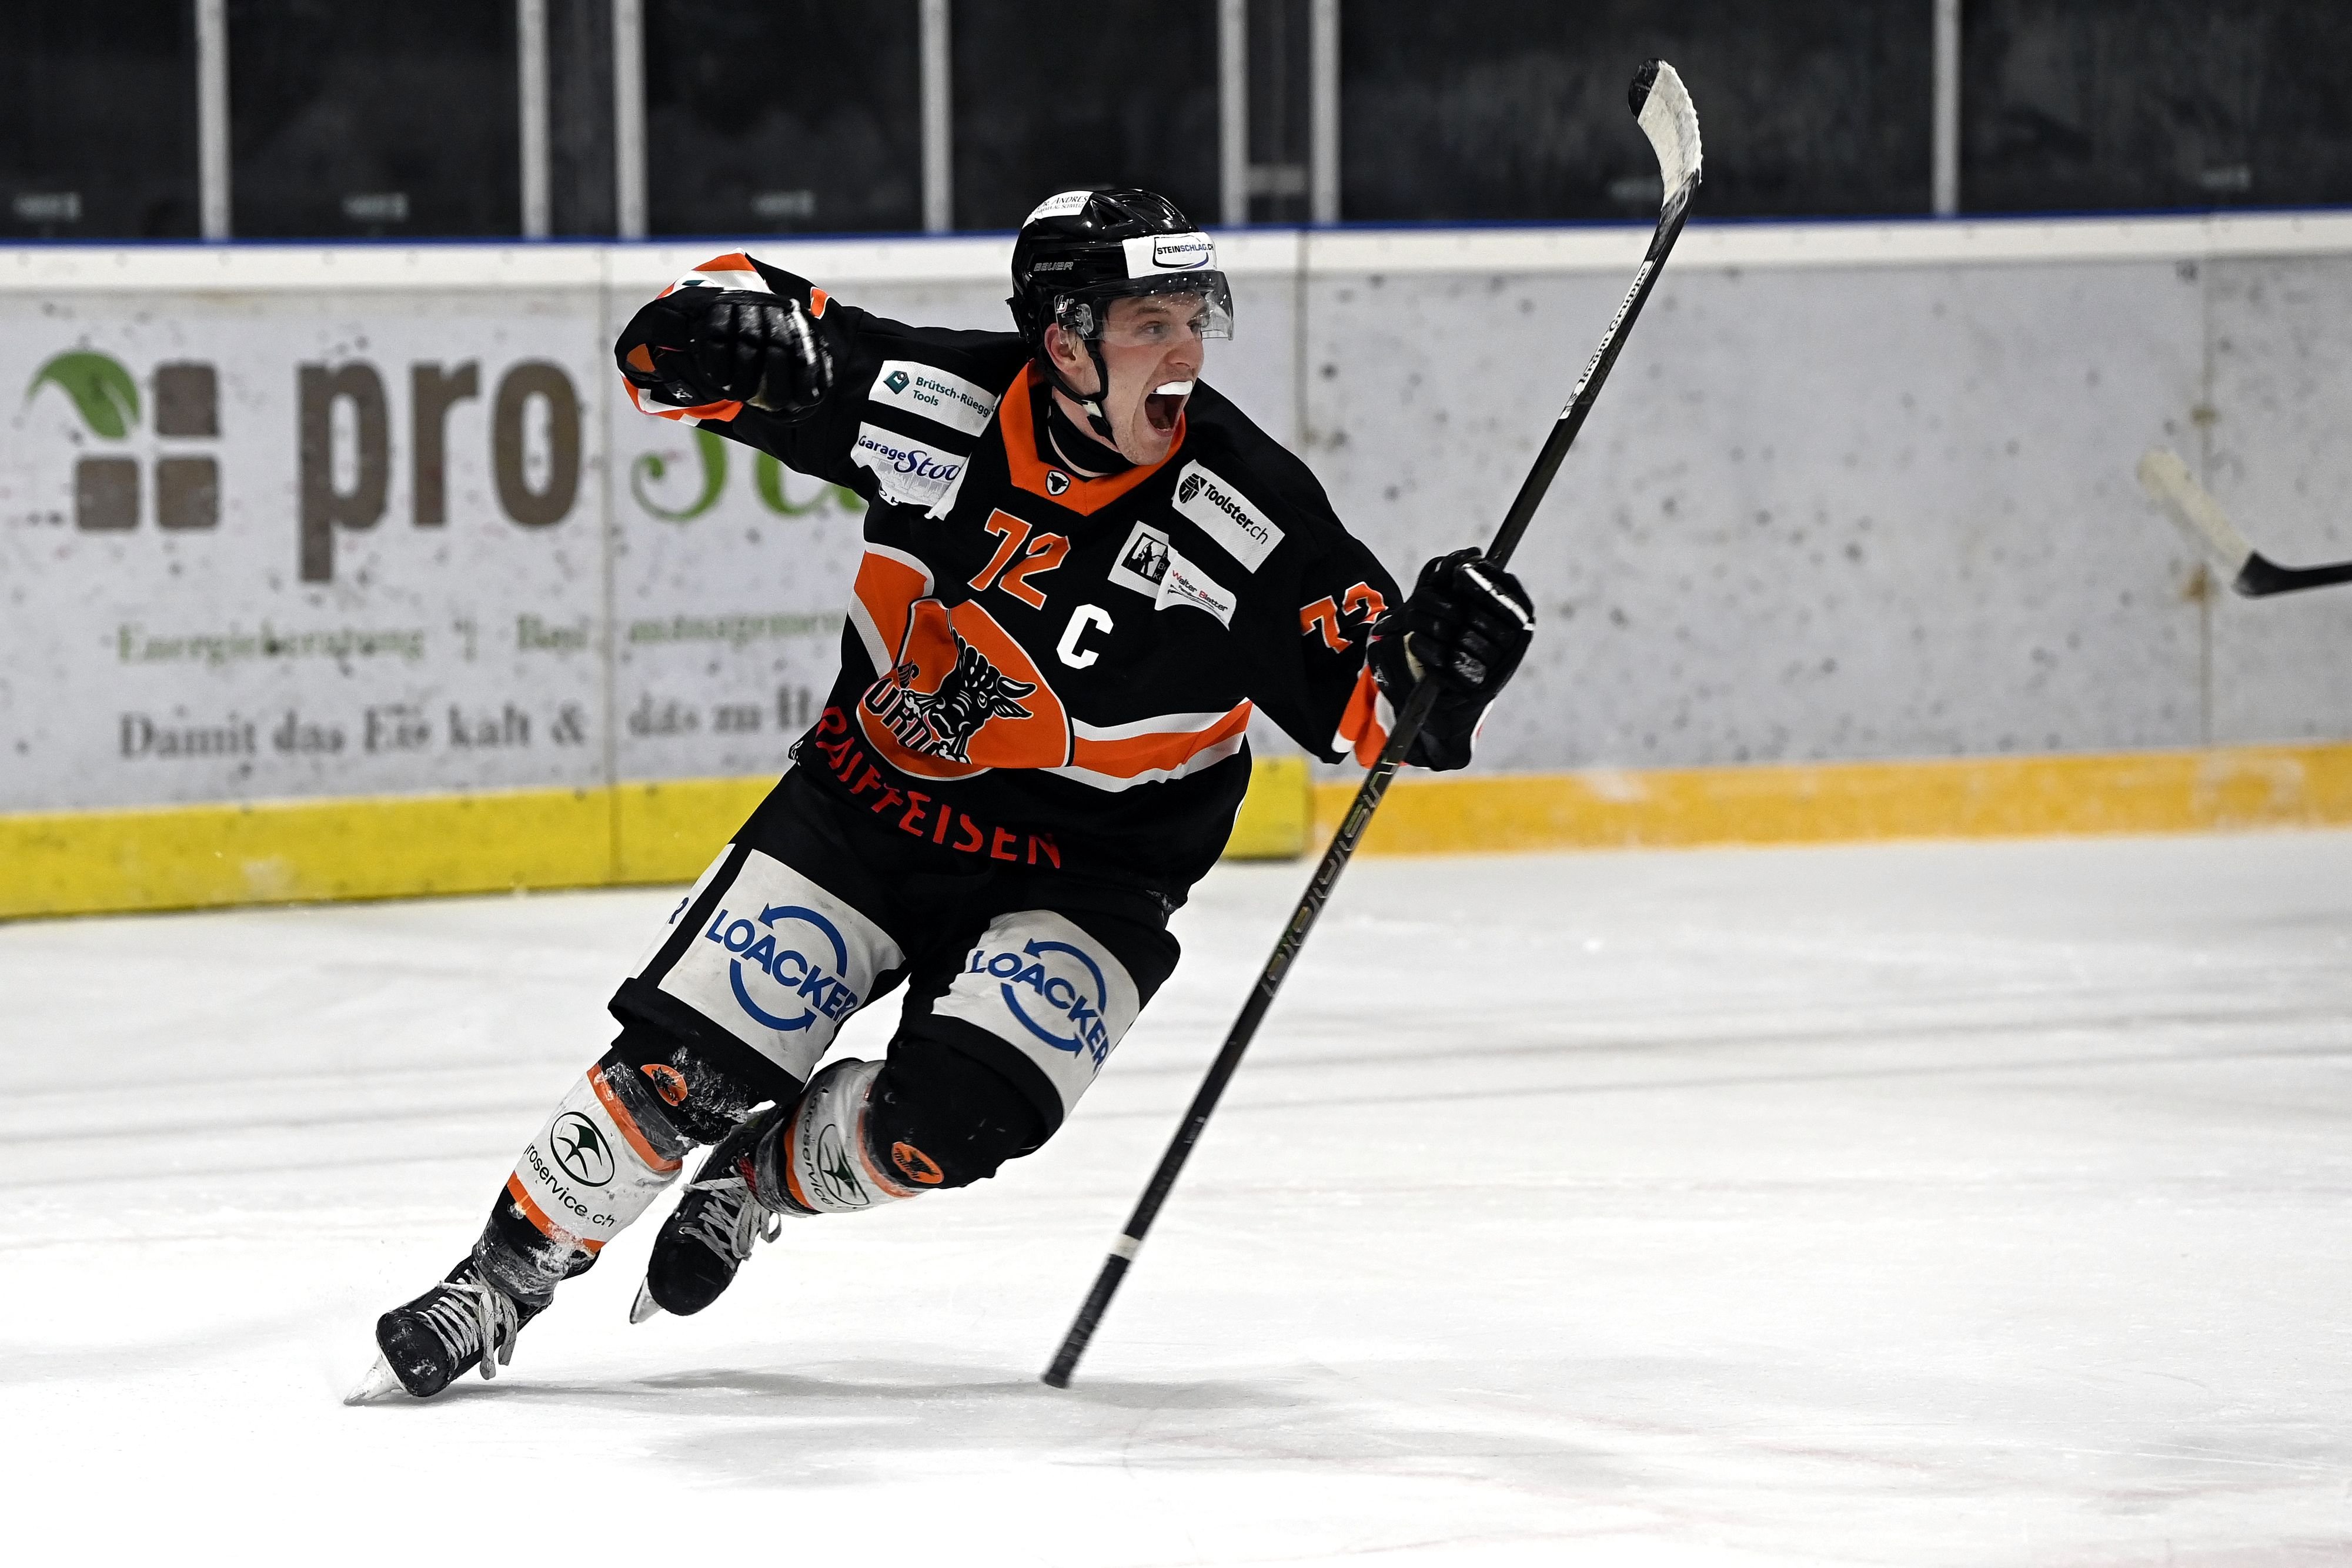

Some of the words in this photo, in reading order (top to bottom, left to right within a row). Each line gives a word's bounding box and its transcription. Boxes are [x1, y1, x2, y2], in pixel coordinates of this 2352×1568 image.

[1051, 196, 1088, 205] ANDRES
[913, 389, 940, 406] Tools
[299, 357, 581, 583] pro
[858, 435, 907, 462] Garage
[1204, 483, 1269, 544] Toolster.ch
[967, 507, 1071, 611] 72
[1172, 570, 1198, 593] Walter
[1198, 590, 1228, 611] Blatter
[1056, 604, 1114, 669] C
[815, 707, 1061, 869] RAIFFEISEN
[704, 909, 858, 1023] LOACKER
[965, 950, 1110, 1075] LOACKER
